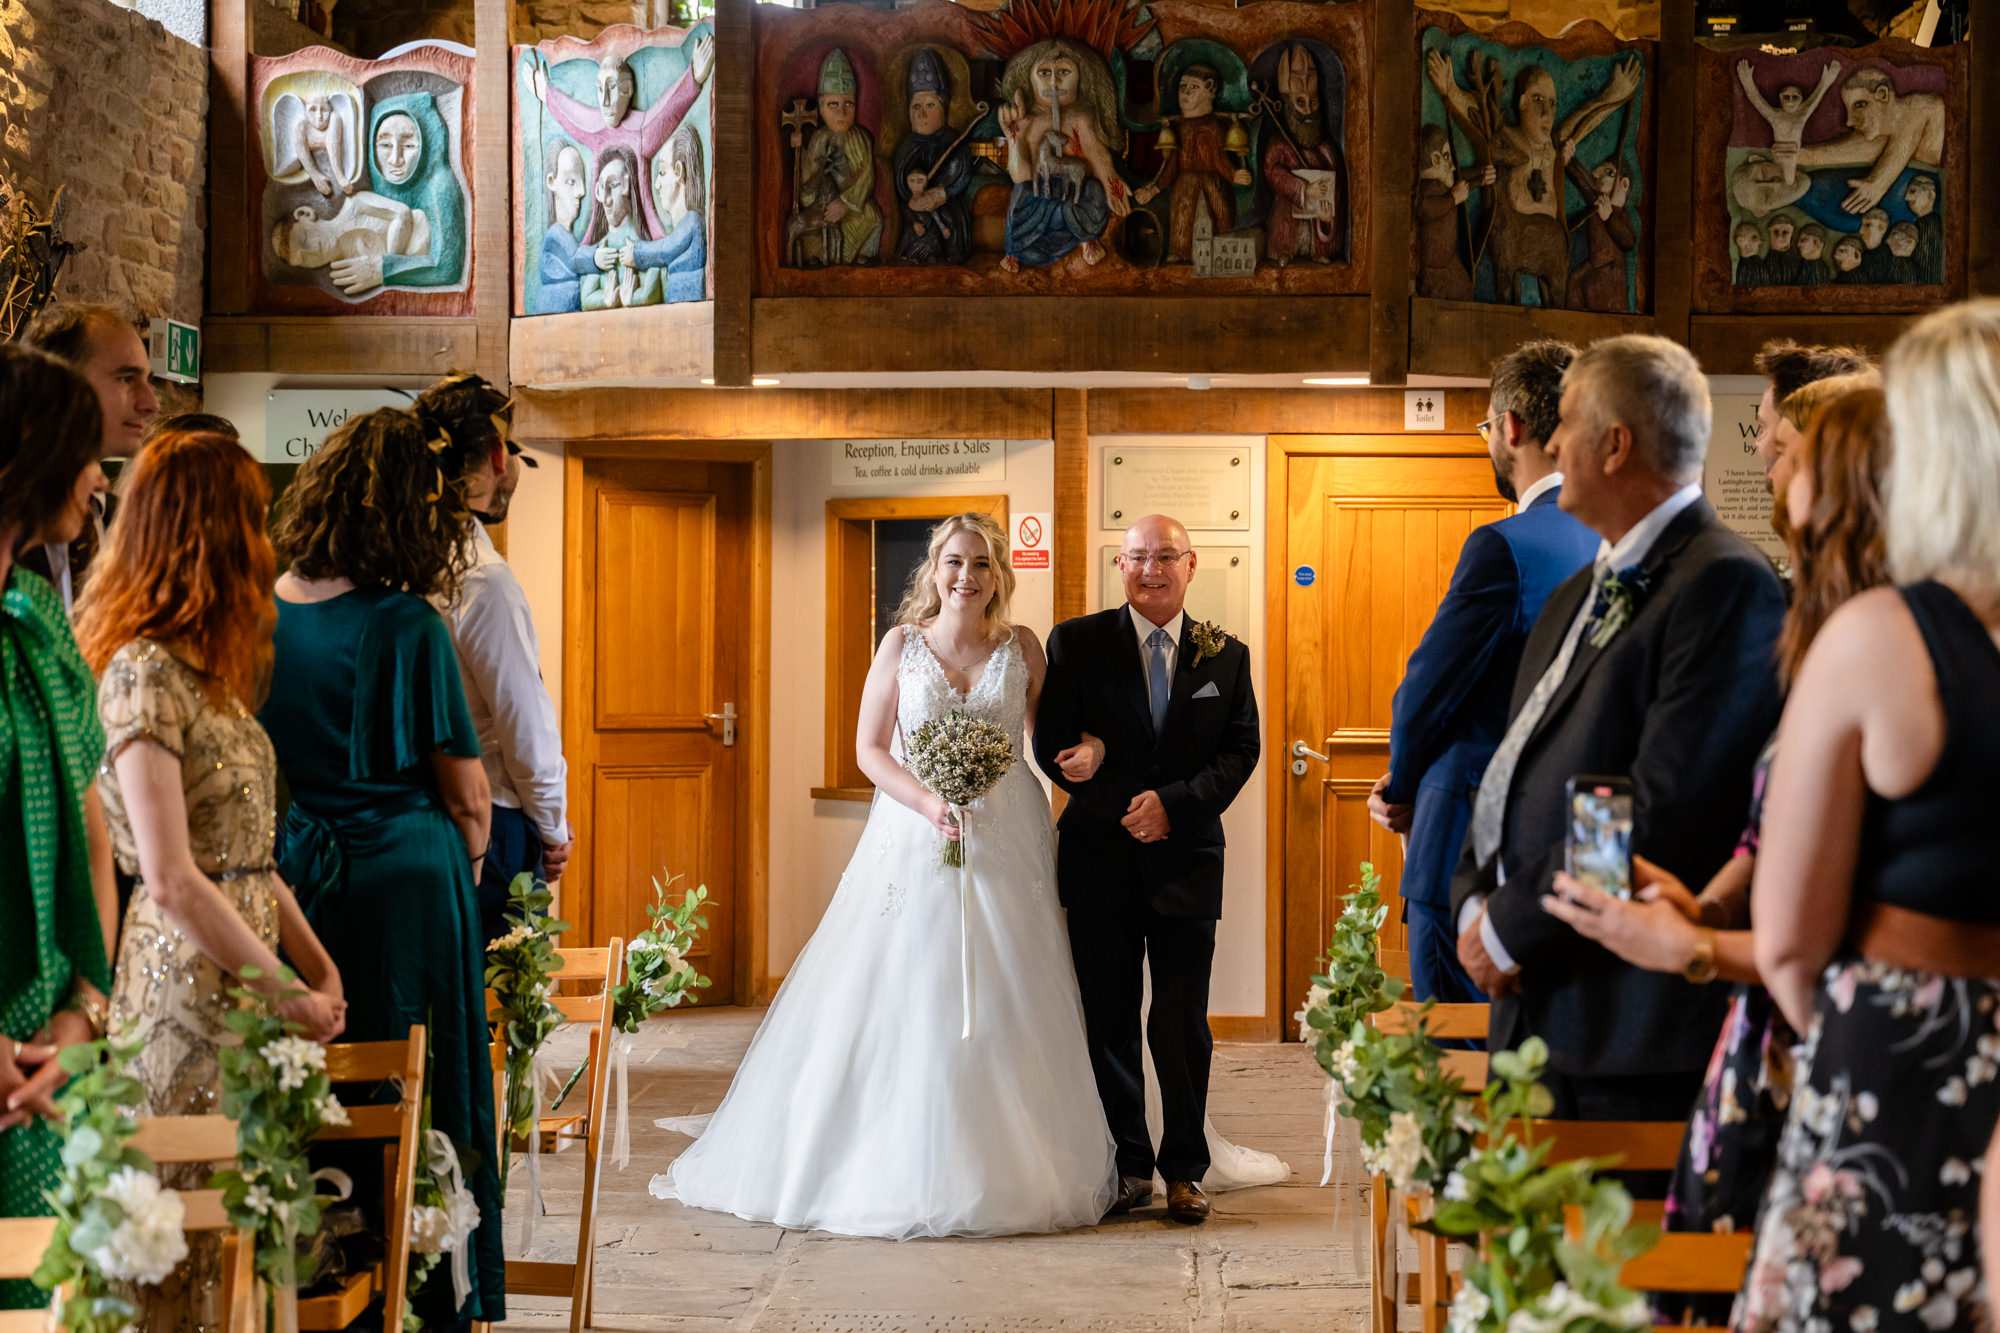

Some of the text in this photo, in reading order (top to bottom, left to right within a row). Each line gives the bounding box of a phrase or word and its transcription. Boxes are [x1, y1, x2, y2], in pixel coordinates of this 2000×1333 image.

[307, 408, 348, 428] Wel
[1416, 414, 1434, 422] Toilet
[845, 439, 991, 460] Reception, Enquiries & Sales
[1744, 441, 1757, 455] by
[870, 465, 892, 477] coffee
[894, 466, 899, 476] &
[901, 464, 917, 476] cold
[919, 464, 943, 476] drinks
[945, 462, 981, 475] available
